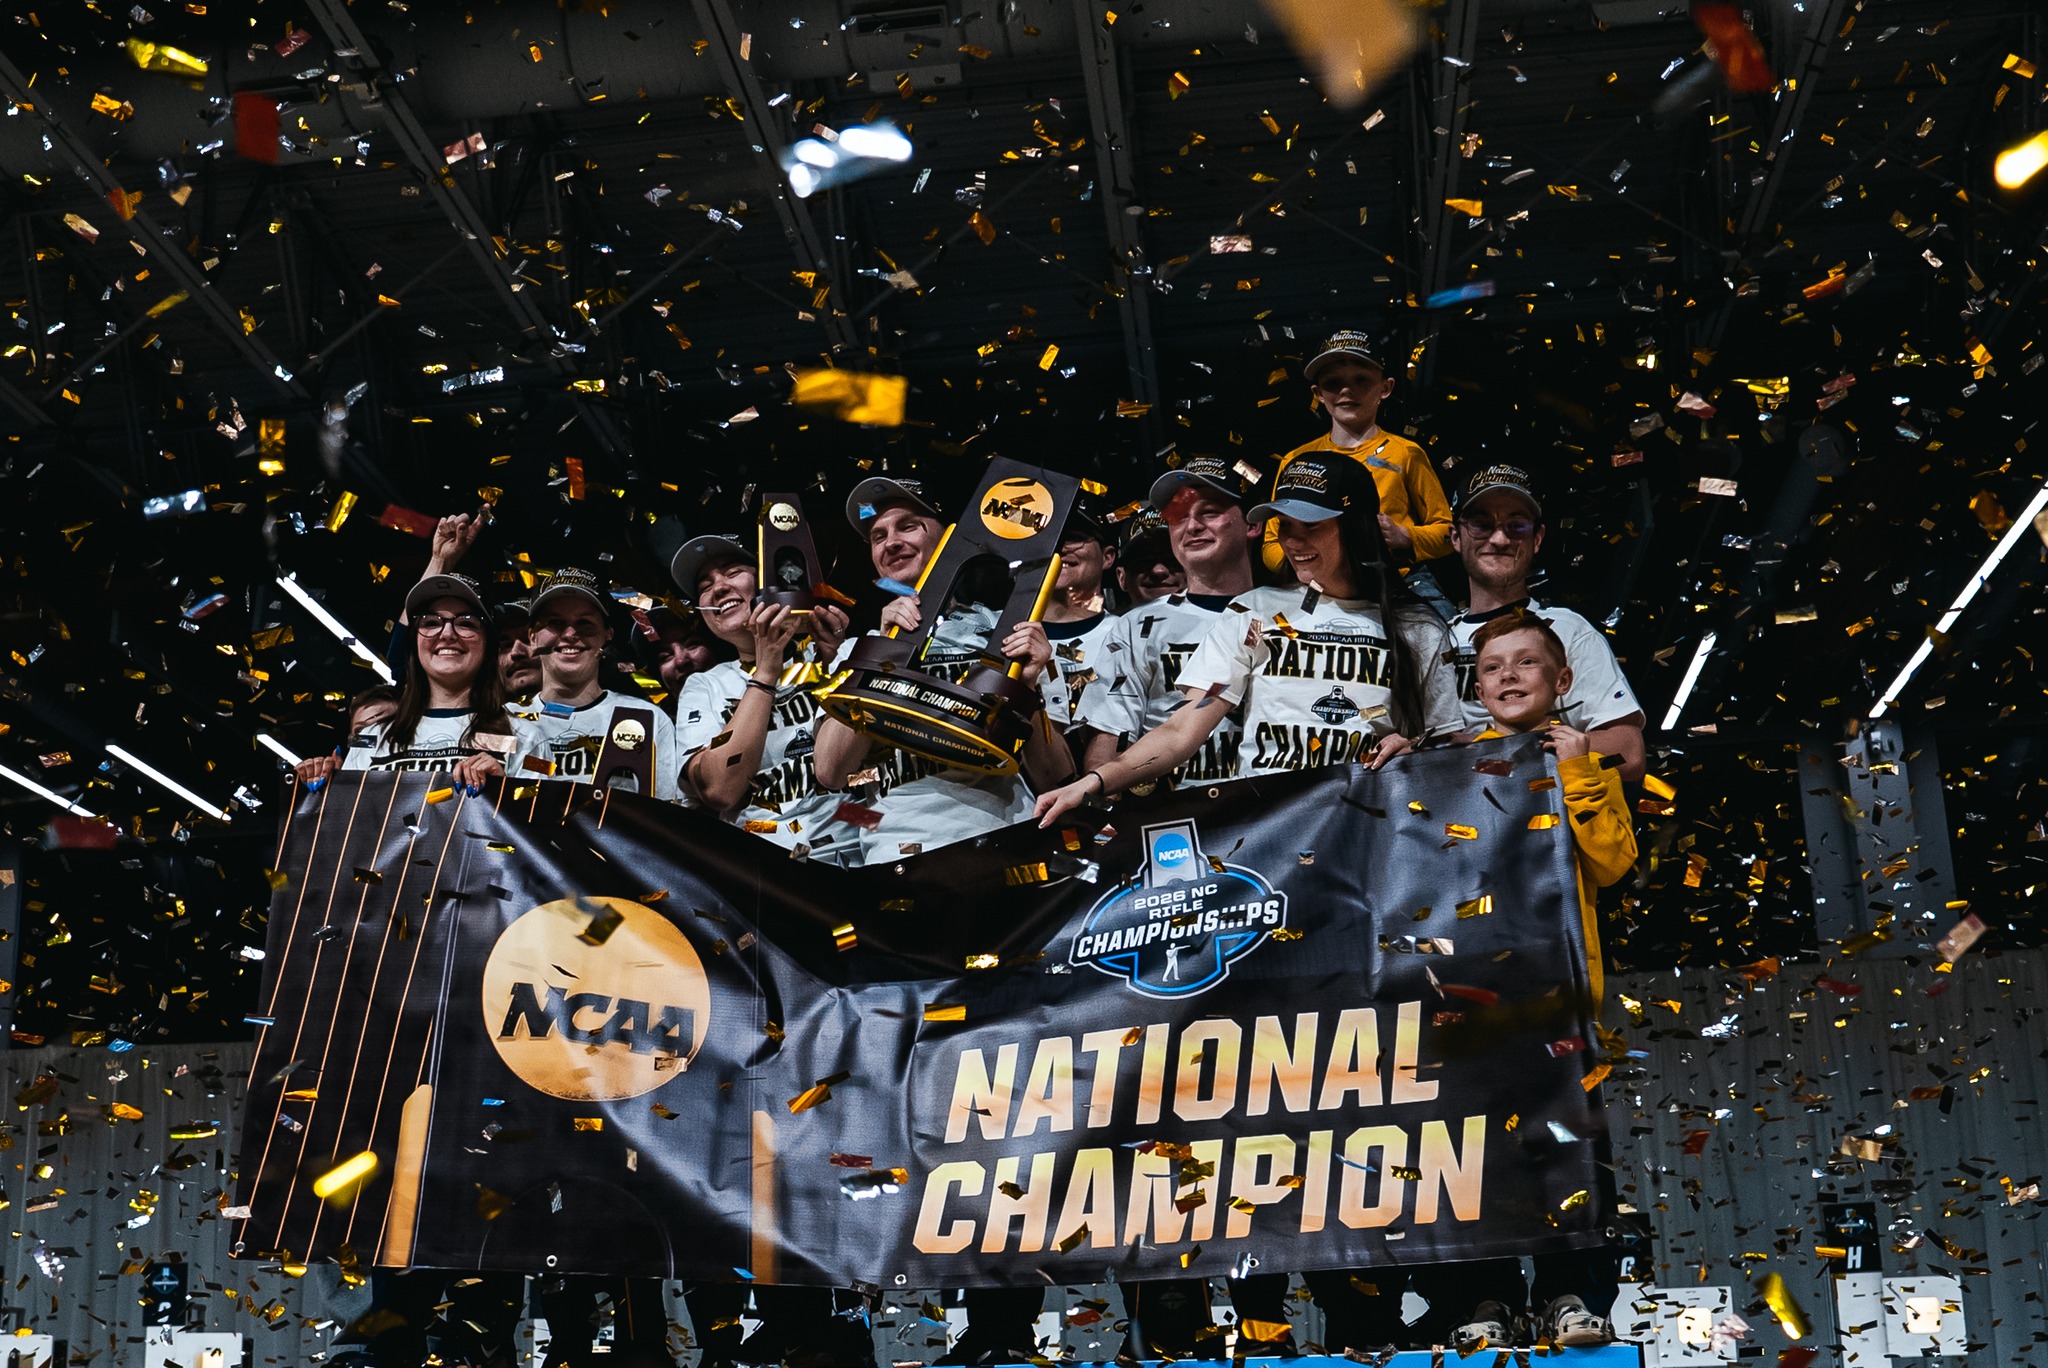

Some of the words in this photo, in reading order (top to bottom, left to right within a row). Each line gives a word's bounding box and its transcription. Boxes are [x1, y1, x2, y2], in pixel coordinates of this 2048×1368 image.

[1487, 465, 1529, 480] National
[773, 515, 799, 523] NCAA
[868, 678, 921, 699] NATIONAL
[920, 691, 981, 720] CHAMPION
[883, 720, 930, 740] NATIONAL
[932, 736, 985, 757] CHAMPION
[1158, 848, 1190, 862] NCAA
[1134, 890, 1186, 910] 2026
[1191, 883, 1218, 899] NC
[1149, 899, 1204, 920] RIFLE
[497, 982, 696, 1059] NCAA
[944, 1000, 1440, 1144] NATIONAL
[912, 1114, 1487, 1254] CHAMPION
[1846, 1246, 1862, 1269] H
